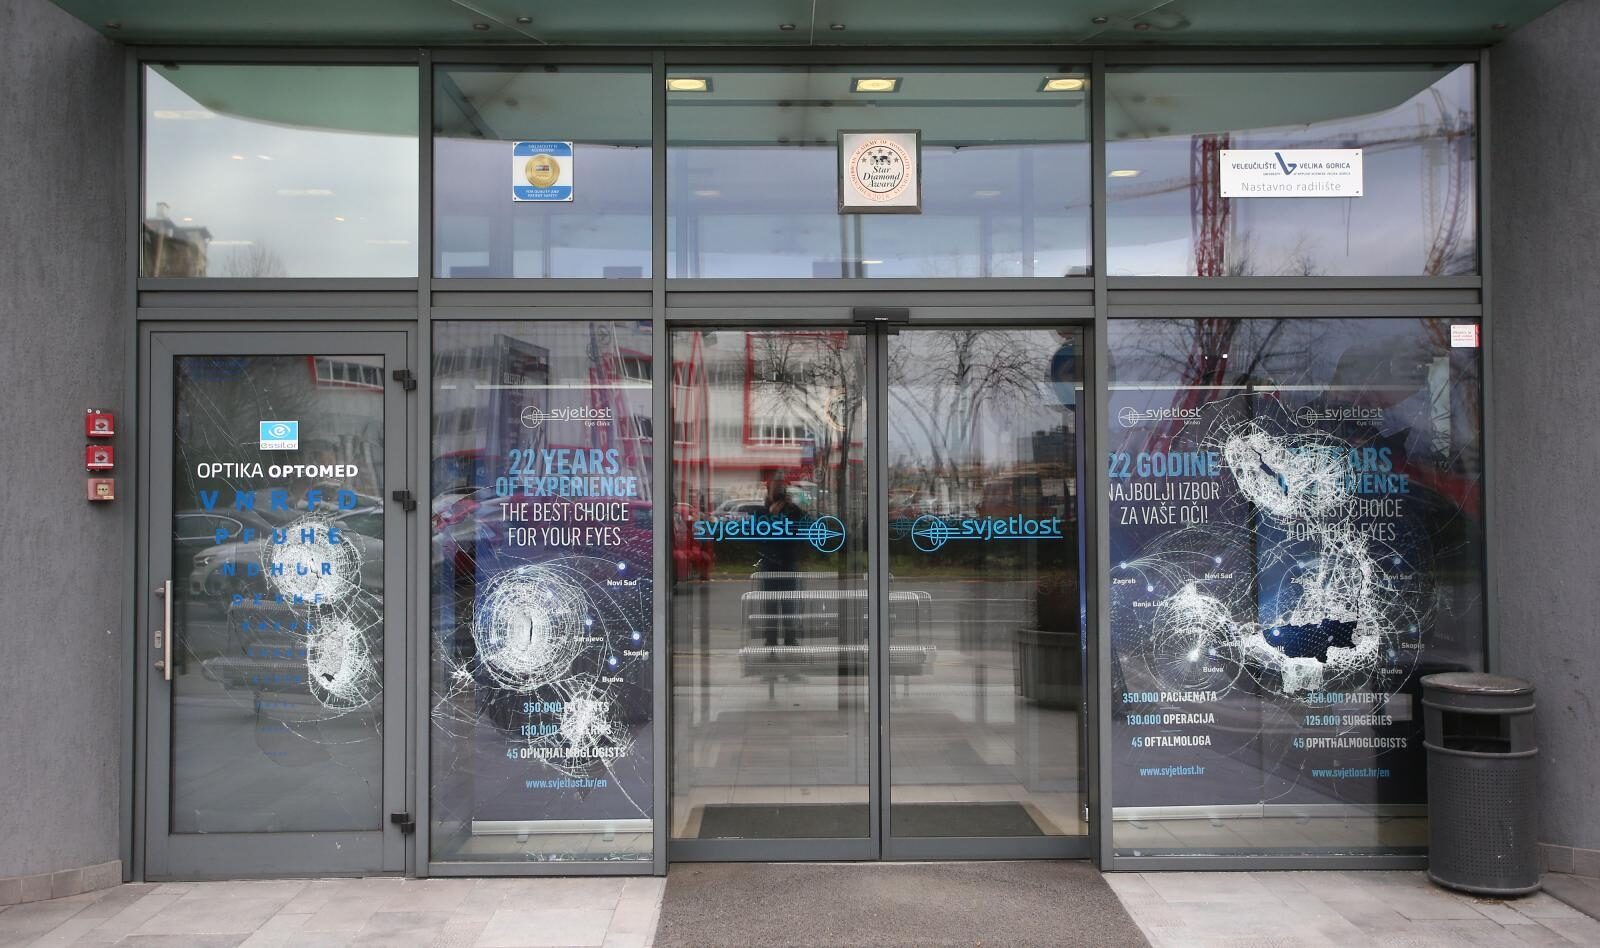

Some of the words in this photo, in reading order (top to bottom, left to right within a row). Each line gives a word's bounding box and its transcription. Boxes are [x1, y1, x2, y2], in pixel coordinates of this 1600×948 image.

[1232, 162, 1276, 170] VELEUČILIŠTE
[863, 172, 900, 181] Diamond
[868, 180, 896, 188] Award
[1242, 182, 1292, 192] Nastavno
[1297, 181, 1341, 191] radilište
[552, 405, 611, 421] svjetlost
[1146, 407, 1200, 421] svjetlost
[1325, 406, 1382, 421] svjetlost
[509, 449, 535, 475] 22
[542, 449, 620, 475] YEARS
[1109, 452, 1131, 477] 22
[1137, 452, 1220, 477] GODINE
[198, 463, 263, 478] OPTIKA
[268, 465, 358, 478] OPTOMED
[496, 477, 518, 497] OF
[524, 477, 637, 497] EXPERIENCE
[1180, 482, 1220, 500] IZBOR
[500, 503, 528, 522] THE
[534, 503, 571, 522] BEST
[574, 503, 629, 522] CHOICE
[1120, 507, 1138, 525] ZA
[1141, 501, 1176, 524] VAŠE
[1181, 501, 1208, 524] OČI!
[1350, 499, 1404, 518] CHOICE
[694, 515, 794, 541] svjetlost
[962, 514, 1061, 540] svjetlost
[1362, 523, 1396, 541] EYES
[508, 528, 536, 546] FOR
[542, 528, 580, 546] YOUR
[586, 527, 621, 546] EYES
[1123, 692, 1159, 703] 350.000
[1160, 691, 1217, 702] PACIJENATA
[1308, 693, 1344, 704] 350.000
[1346, 692, 1390, 703] PATIENTS
[524, 702, 561, 713] 350.000
[1127, 714, 1161, 725] 130.000
[1164, 713, 1214, 724] OPERACIJA
[1306, 715, 1340, 726] 125.000
[1342, 715, 1392, 726] SURGERIES
[521, 725, 558, 736] 130.000
[1132, 736, 1142, 747] 45
[1144, 735, 1211, 747] OFTALMOLOGA
[1293, 738, 1304, 748] 45
[1306, 737, 1407, 748] OPHTHALMOGLOGISTS
[507, 748, 518, 759] 45
[1140, 766, 1205, 777] www.svjetlost.hr
[1312, 768, 1390, 779] www.svjetlost.hr/en
[526, 778, 607, 790] www.svjetlost.hr/en
